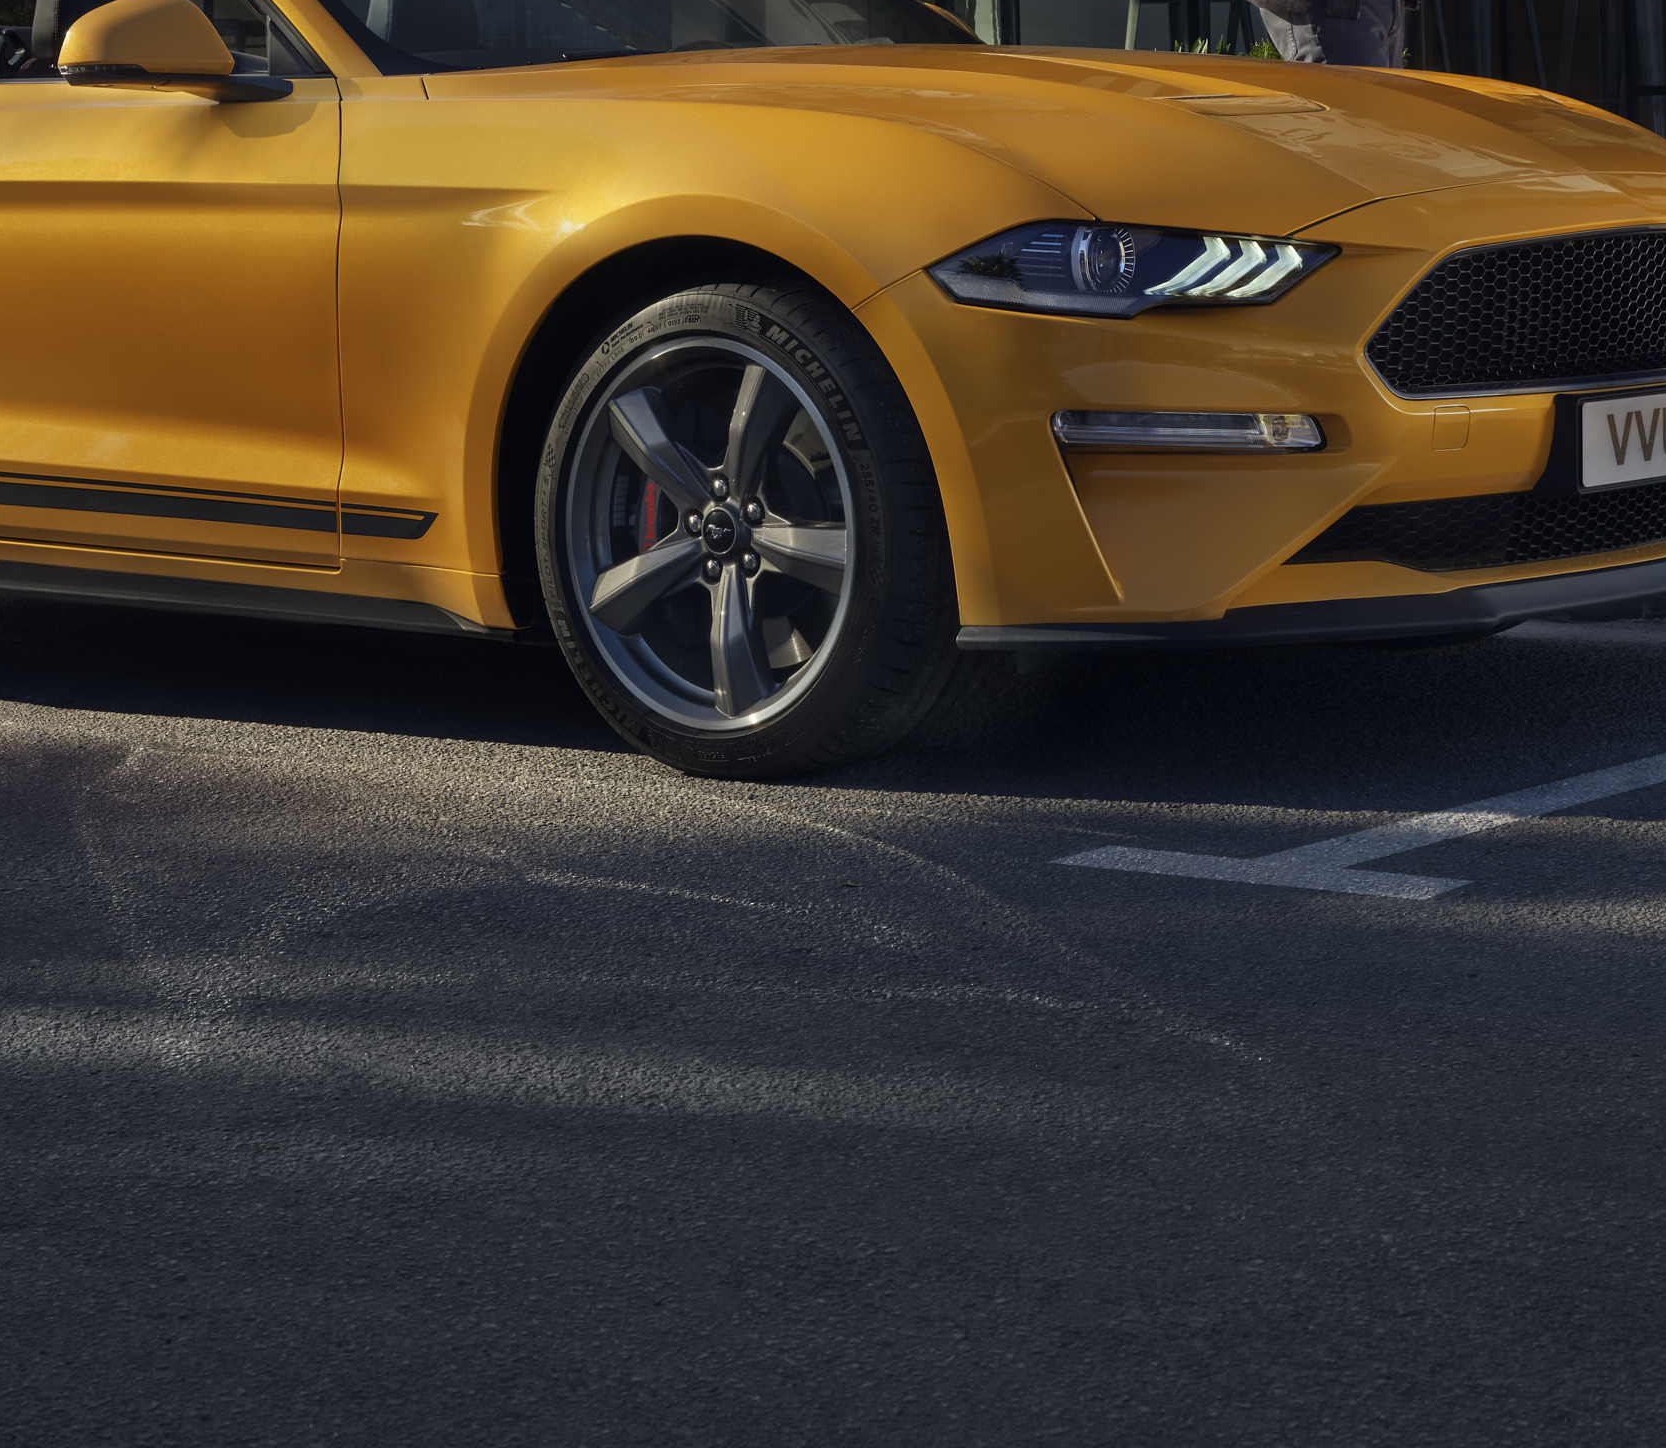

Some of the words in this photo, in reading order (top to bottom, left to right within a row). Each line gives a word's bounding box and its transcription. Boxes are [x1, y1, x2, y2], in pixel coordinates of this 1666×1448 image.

[765, 324, 863, 441] MICHELIN
[645, 483, 654, 540] brembo
[558, 620, 642, 736] MICHELIN
